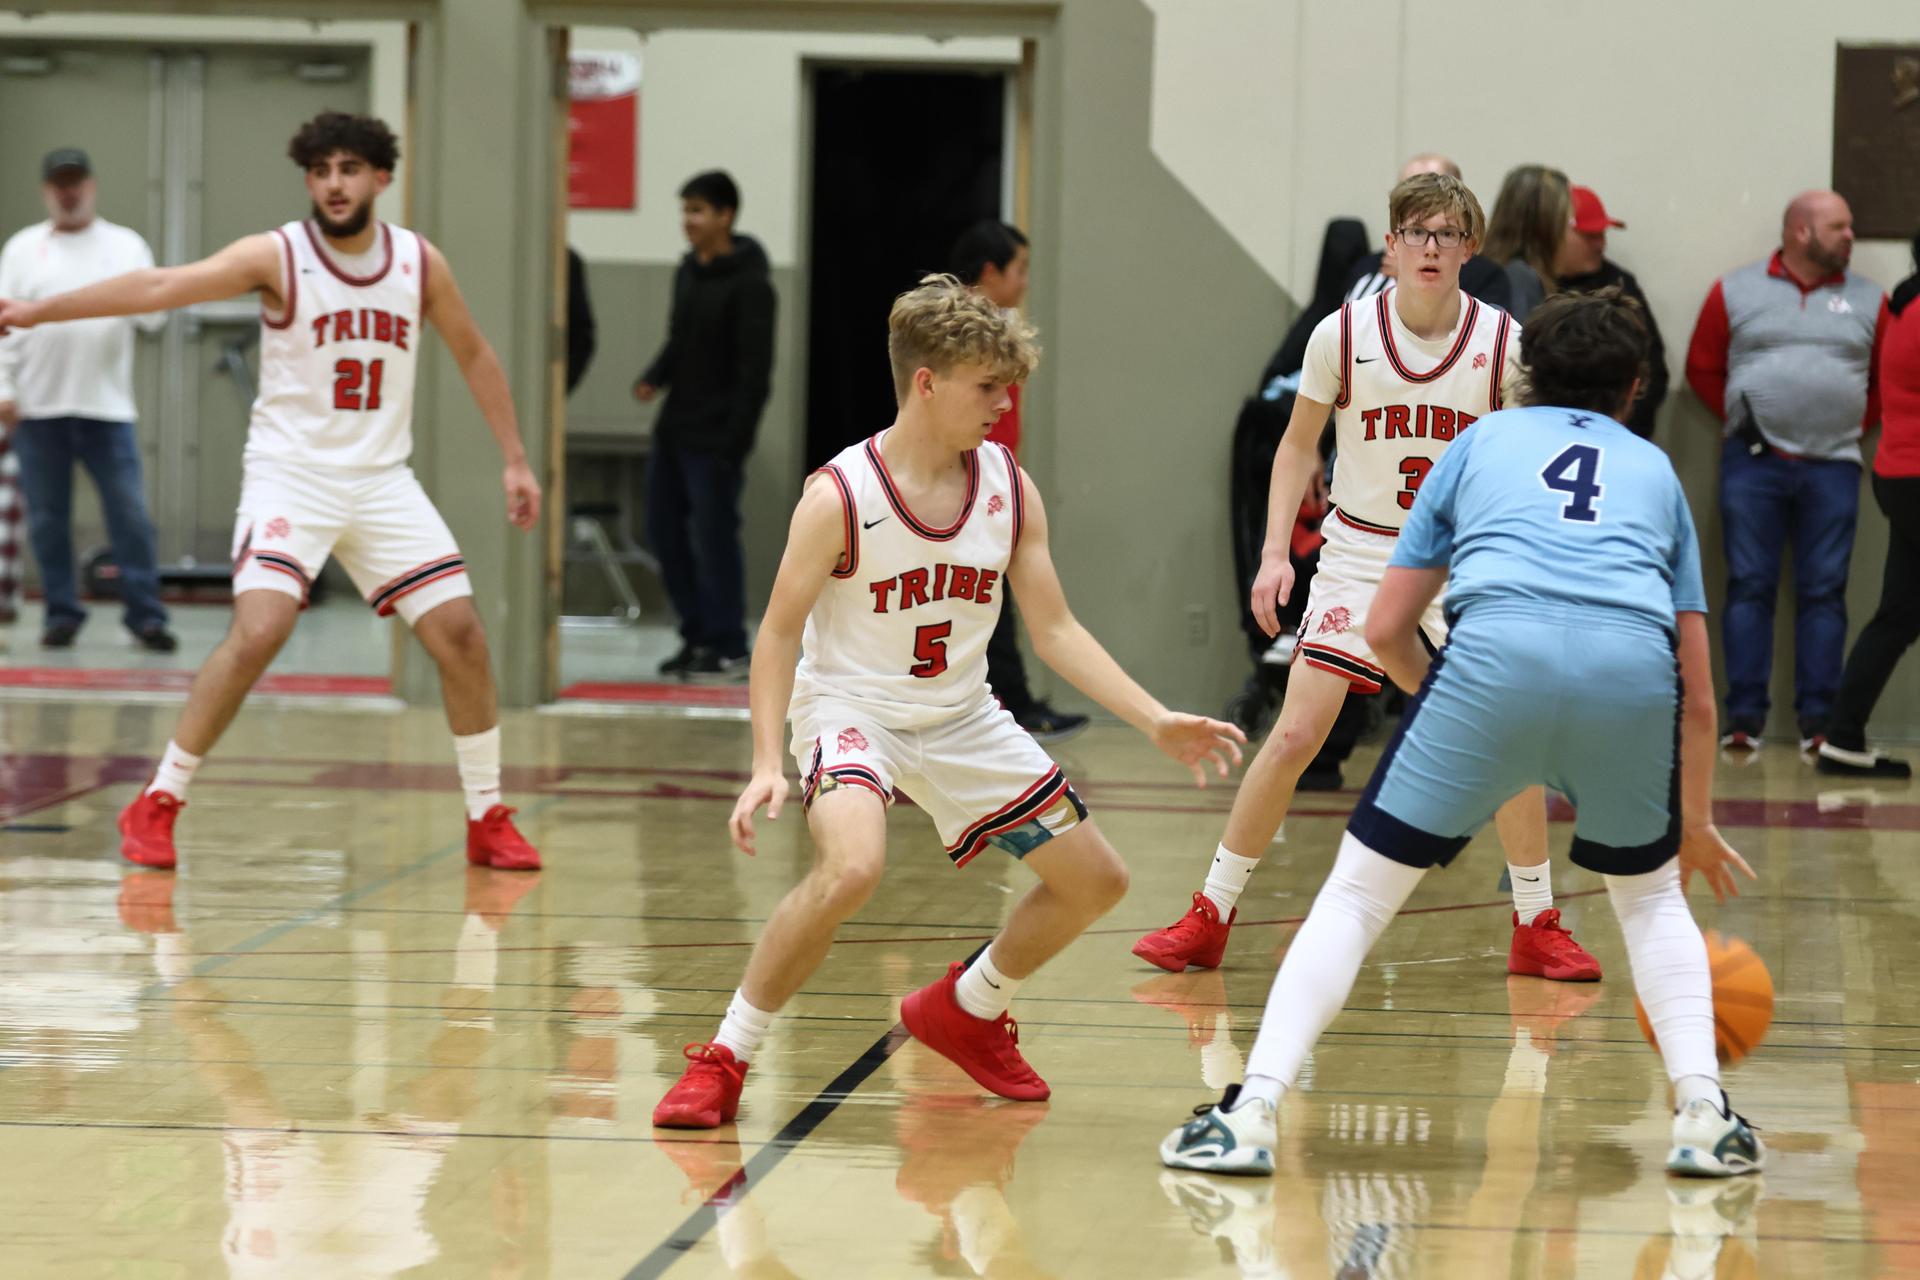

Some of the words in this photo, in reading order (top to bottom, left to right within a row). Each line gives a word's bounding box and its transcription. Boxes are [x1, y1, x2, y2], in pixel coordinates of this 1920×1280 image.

[311, 309, 410, 351] TRIBE
[333, 357, 384, 411] 21
[1396, 456, 1434, 510] 3
[1538, 442, 1604, 524] 4
[869, 563, 999, 613] TRIBE
[909, 619, 952, 678] 5
